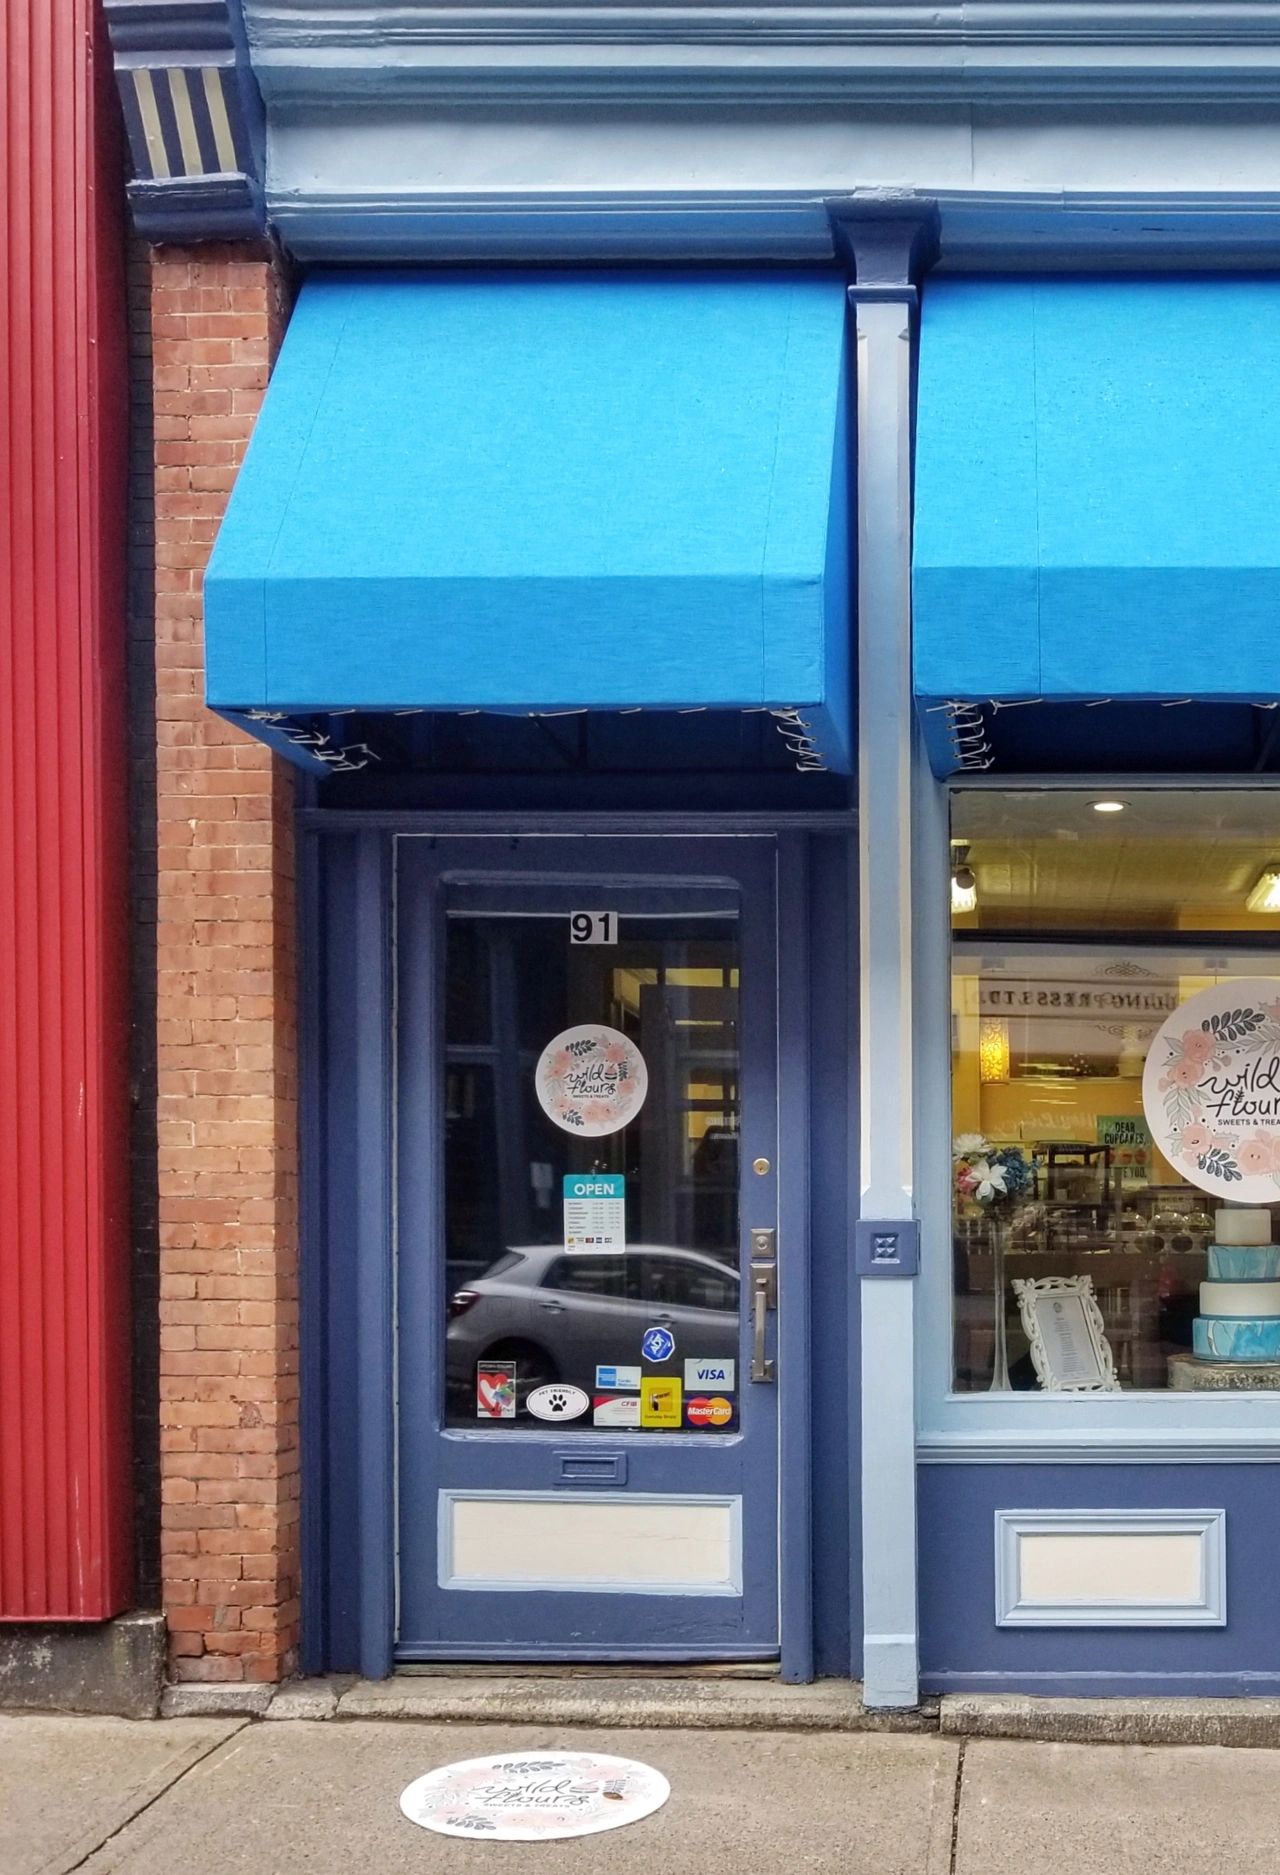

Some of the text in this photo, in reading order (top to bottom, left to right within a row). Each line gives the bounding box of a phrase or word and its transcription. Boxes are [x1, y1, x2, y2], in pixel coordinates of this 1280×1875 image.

[572, 913, 612, 942] 91
[564, 1064, 605, 1083] wild
[1198, 1057, 1280, 1094] wild
[567, 1082, 617, 1096] flours
[1115, 1122, 1135, 1133] DEAR
[1217, 1118, 1251, 1126] SWEETS
[1252, 1118, 1259, 1126] &
[574, 1183, 615, 1196] OPEN
[697, 1369, 725, 1380] VISA
[687, 1407, 732, 1416] MasterCard
[472, 1780, 572, 1794] wild
[475, 1791, 590, 1806] flours
